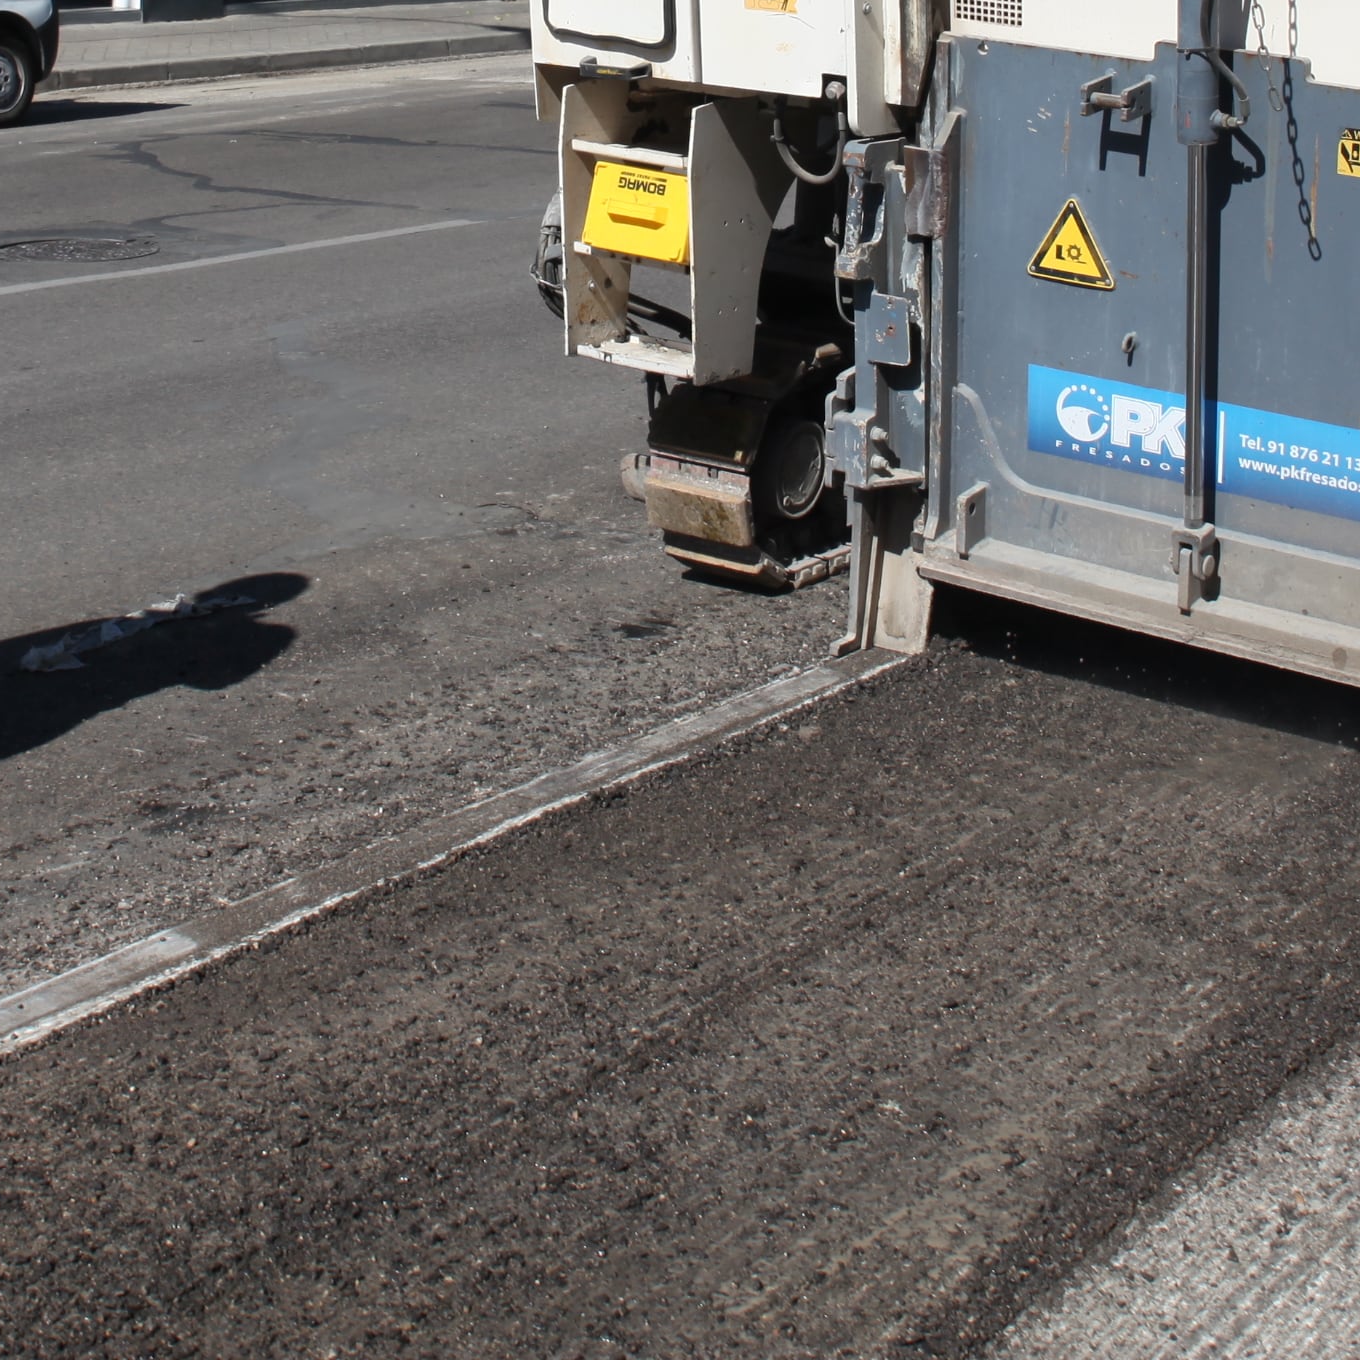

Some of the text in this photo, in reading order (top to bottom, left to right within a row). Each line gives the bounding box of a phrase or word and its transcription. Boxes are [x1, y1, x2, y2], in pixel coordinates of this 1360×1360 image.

[618, 176, 667, 196] BOMAG
[1110, 393, 1186, 460] PK
[1239, 433, 1265, 452] Tel.
[1267, 440, 1286, 456] 91
[1289, 444, 1319, 462] 876
[1321, 451, 1340, 467] 21
